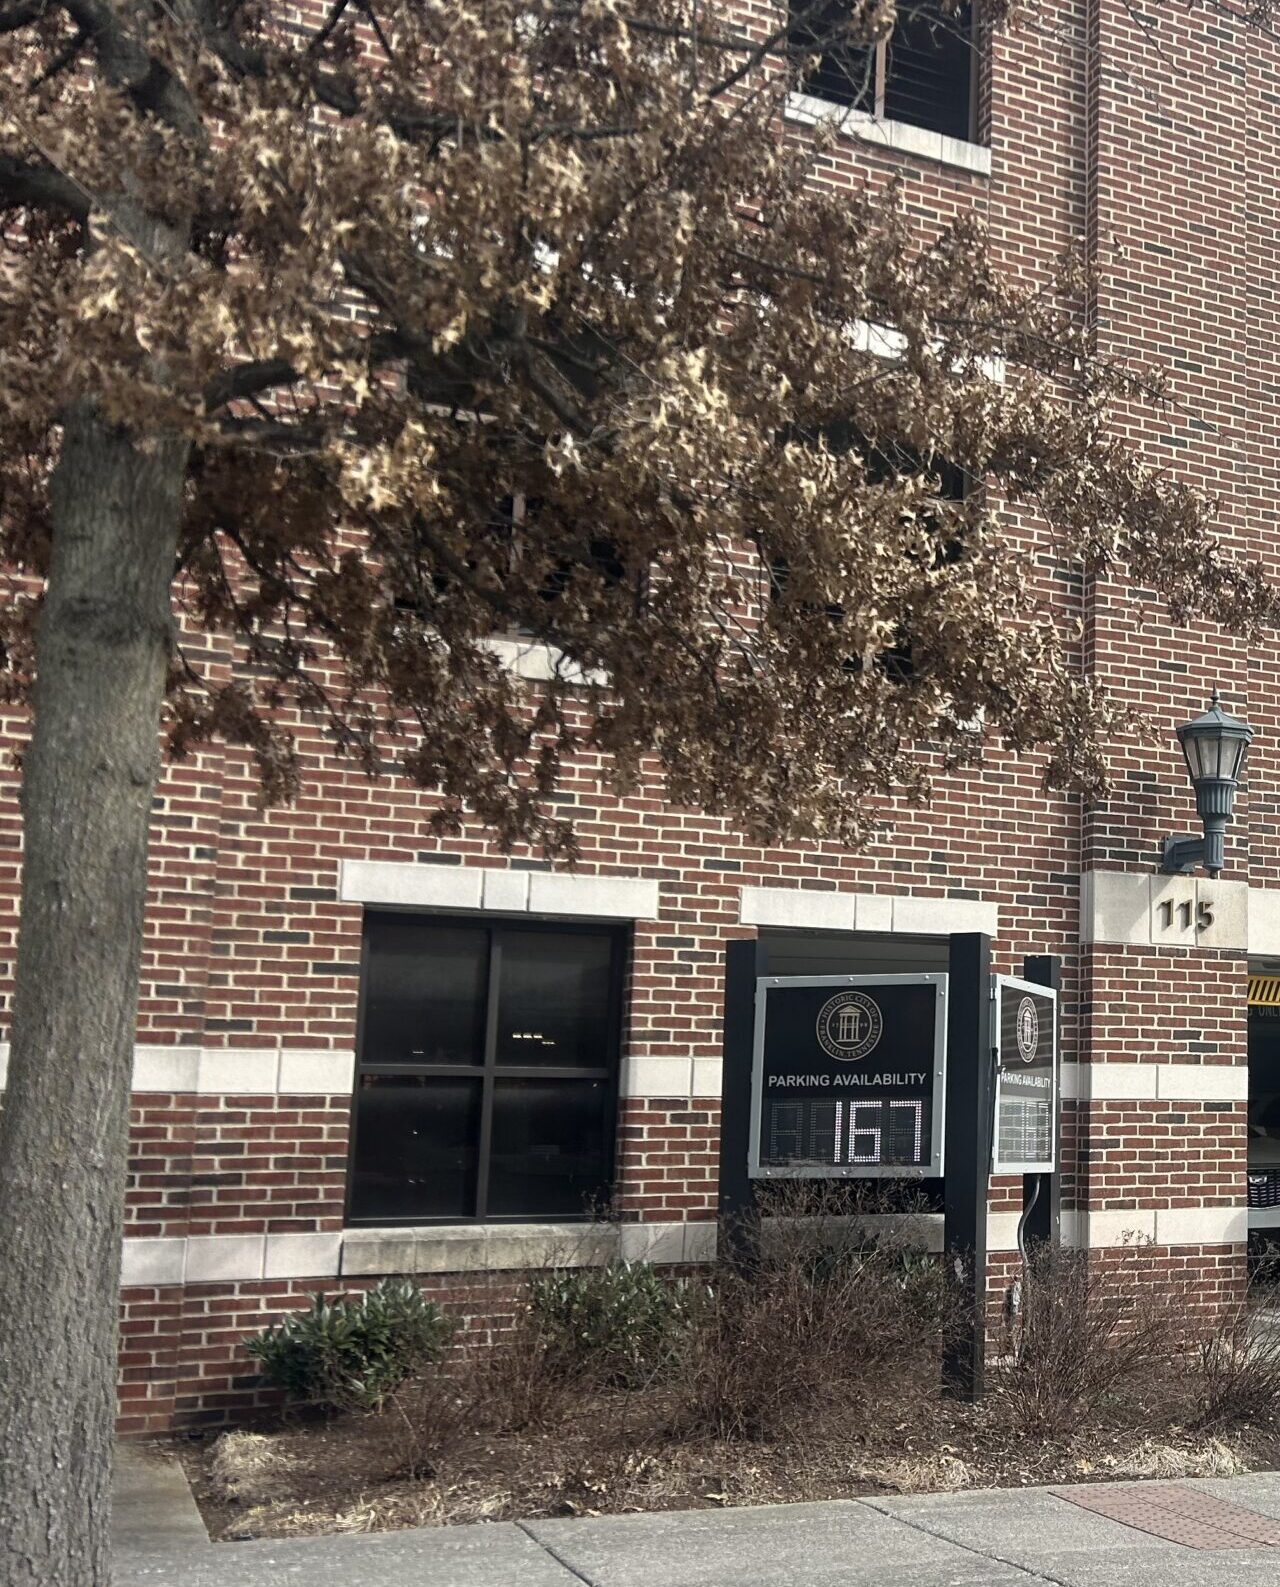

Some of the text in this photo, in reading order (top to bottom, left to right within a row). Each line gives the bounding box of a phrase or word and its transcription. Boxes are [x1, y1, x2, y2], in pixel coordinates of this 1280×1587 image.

[1158, 898, 1215, 931] 115
[822, 995, 854, 1018] HISTORIC
[855, 995, 871, 1008] CITY
[768, 1073, 927, 1087] PARKING AVAILABILITY
[1001, 1071, 1022, 1085] PARKING
[834, 1100, 922, 1163] 167
